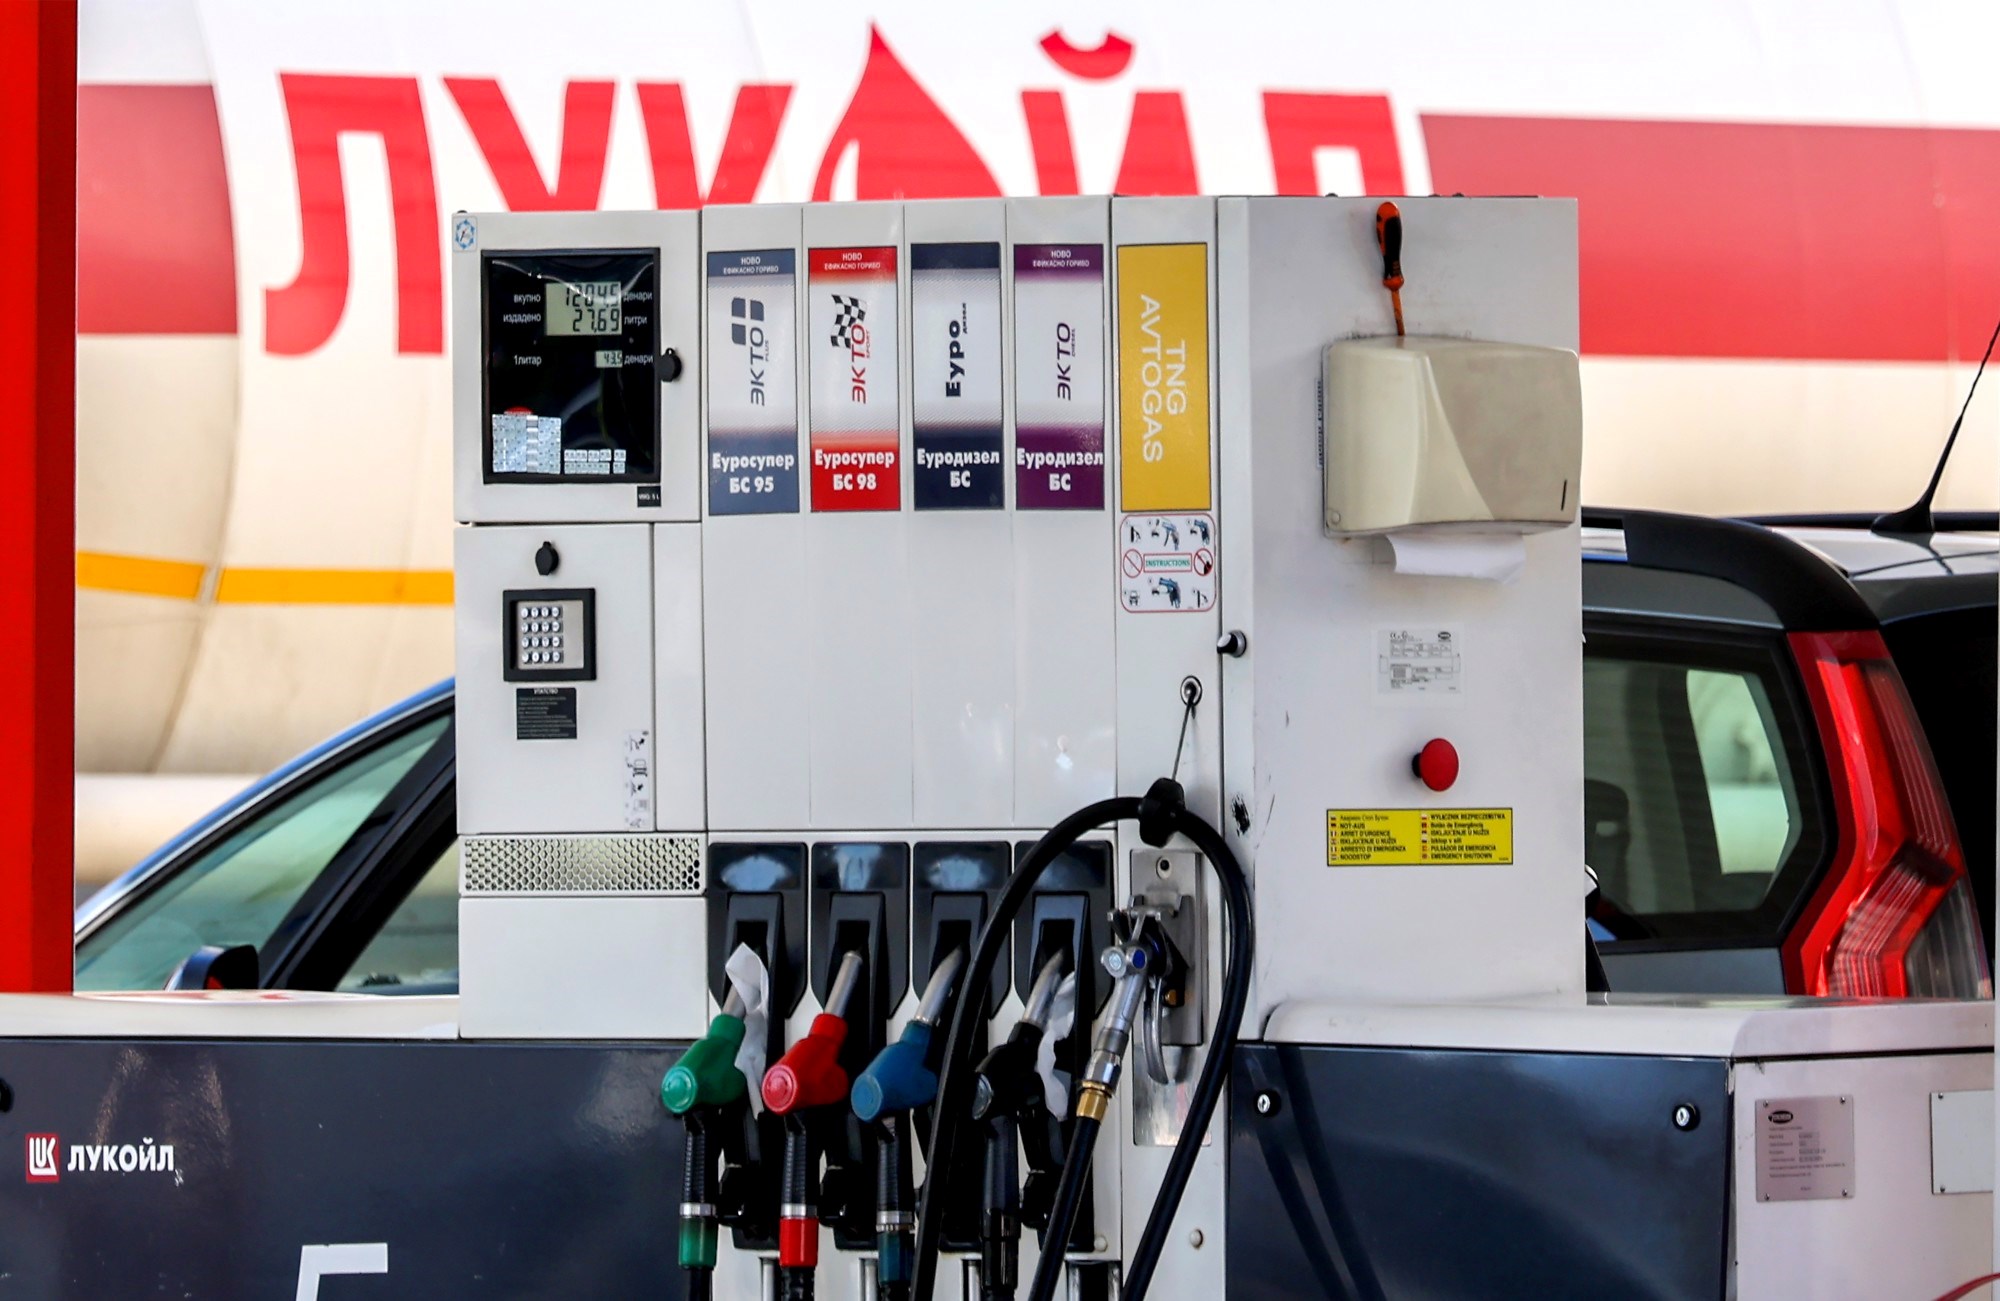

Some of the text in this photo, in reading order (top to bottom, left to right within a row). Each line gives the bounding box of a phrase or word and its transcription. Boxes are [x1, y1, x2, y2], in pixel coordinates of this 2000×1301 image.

[740, 256, 761, 265] НОВО
[842, 252, 863, 262] НОВО
[1050, 250, 1071, 259] НОВО
[723, 265, 779, 275] ЕФИКАСНО ГОРИВО
[824, 262, 881, 271] ЕФИКАСНО ГОРИВО
[513, 294, 541, 305] вкупно
[624, 292, 653, 302] денари
[503, 314, 542, 324] издадено
[624, 316, 648, 326] литри
[624, 355, 654, 366] денари
[750, 327, 765, 406] ЭКТО
[851, 323, 866, 404] ЭКТО
[945, 320, 965, 397] Еуро
[1056, 322, 1071, 401] ЭКТО
[1140, 293, 1164, 463] AVTOGAS
[1166, 339, 1187, 416] TNG
[712, 452, 795, 473] Еуросупер
[814, 448, 895, 470] Еуросупер
[916, 447, 1000, 469] Еуродизел
[1016, 447, 1104, 470] Еуродизел
[729, 476, 774, 494] БС 95
[832, 473, 877, 491] БС 98
[949, 470, 971, 488] БС
[1048, 473, 1072, 491] БС
[1145, 558, 1190, 568] INSTRUCTIONS
[67, 1136, 174, 1173] ЛУКОЙЛ
